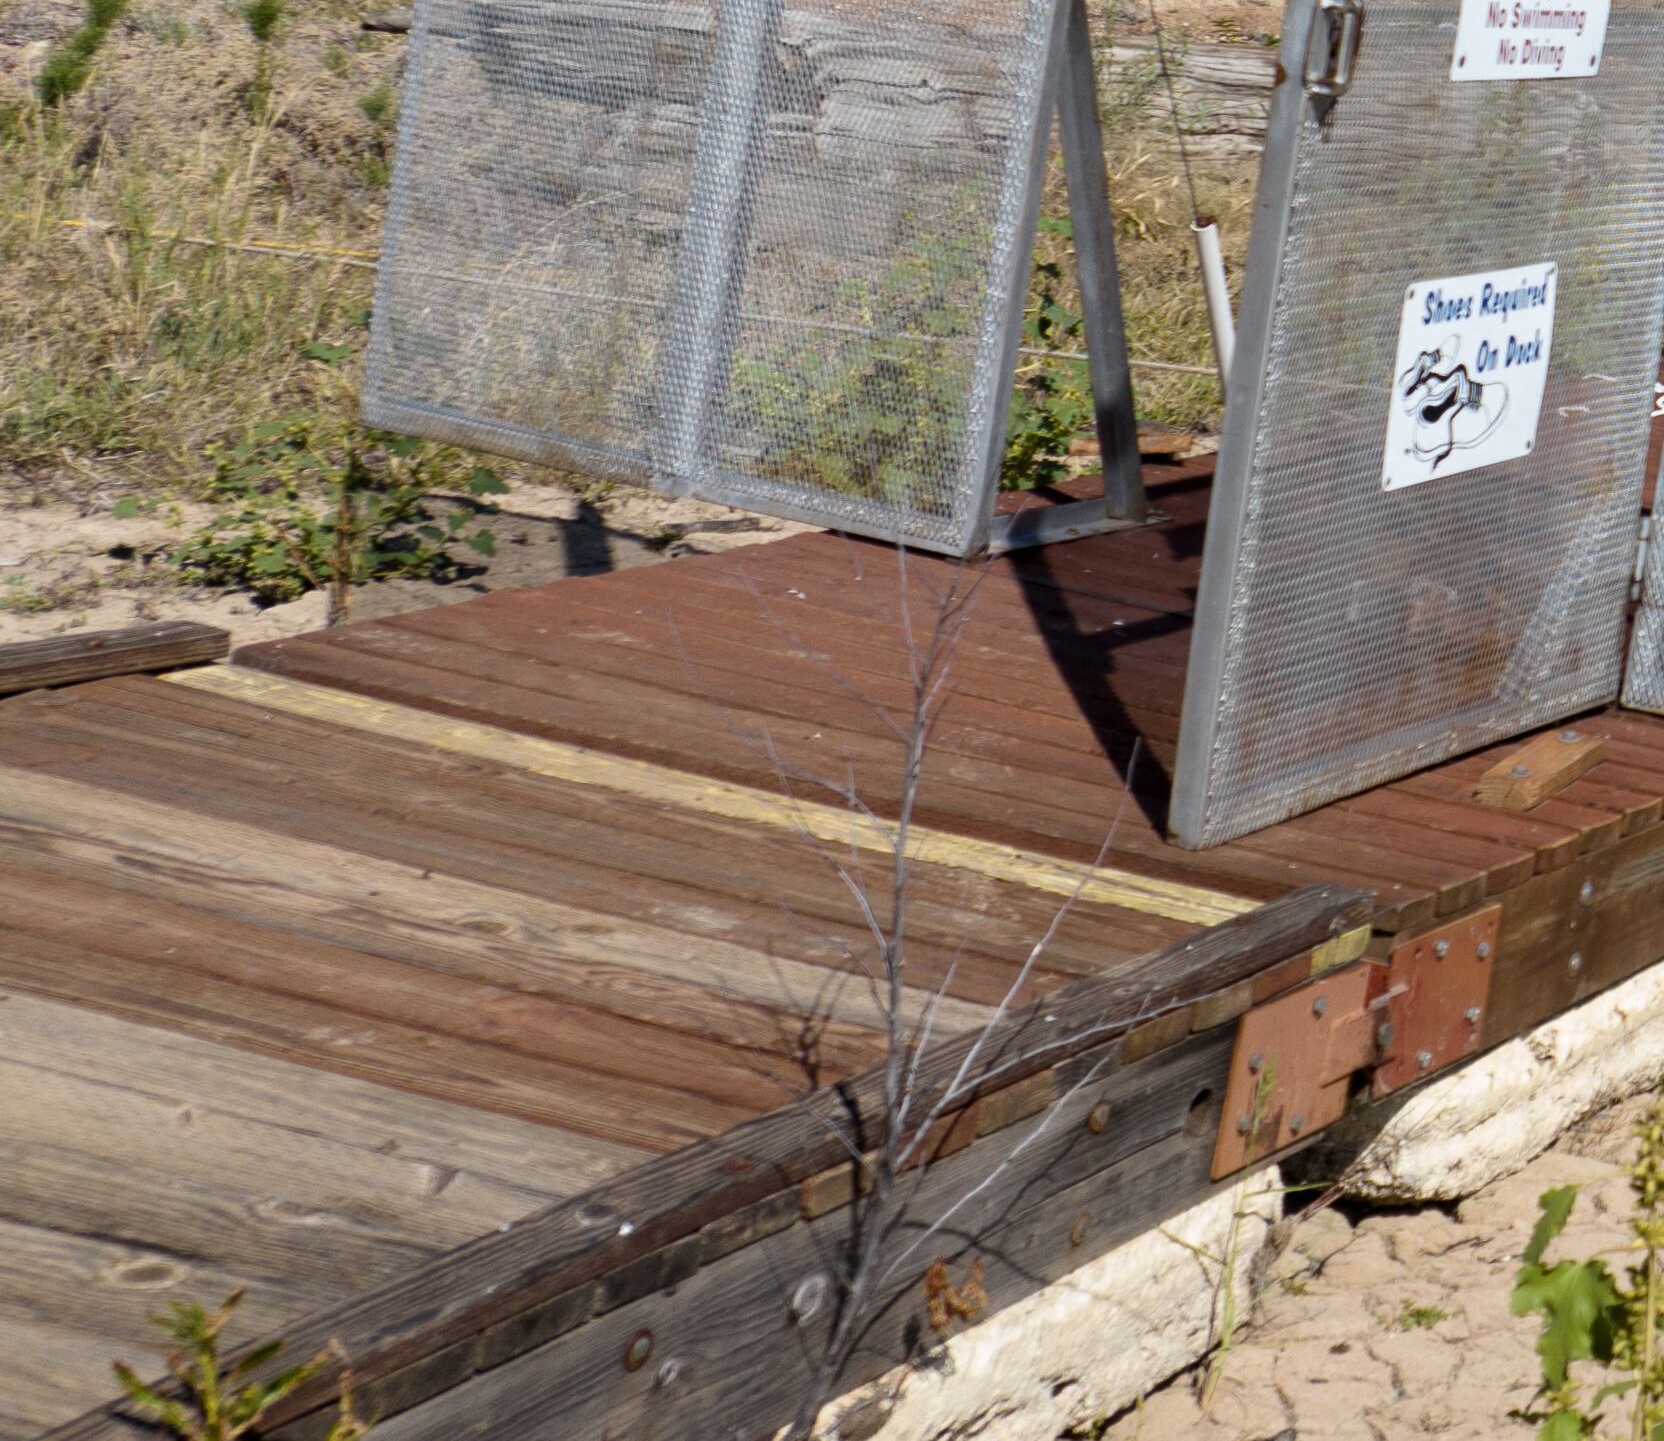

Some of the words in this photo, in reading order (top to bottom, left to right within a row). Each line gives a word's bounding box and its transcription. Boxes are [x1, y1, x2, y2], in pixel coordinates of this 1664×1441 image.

[1485, 2, 1507, 29] No
[1511, 2, 1587, 36] Swimming
[1496, 39, 1518, 65] No
[1520, 38, 1566, 71] Diving
[1421, 287, 1474, 325] Shoes
[1479, 273, 1550, 322] Required
[1476, 339, 1499, 373] On
[1505, 327, 1543, 368] Dock
